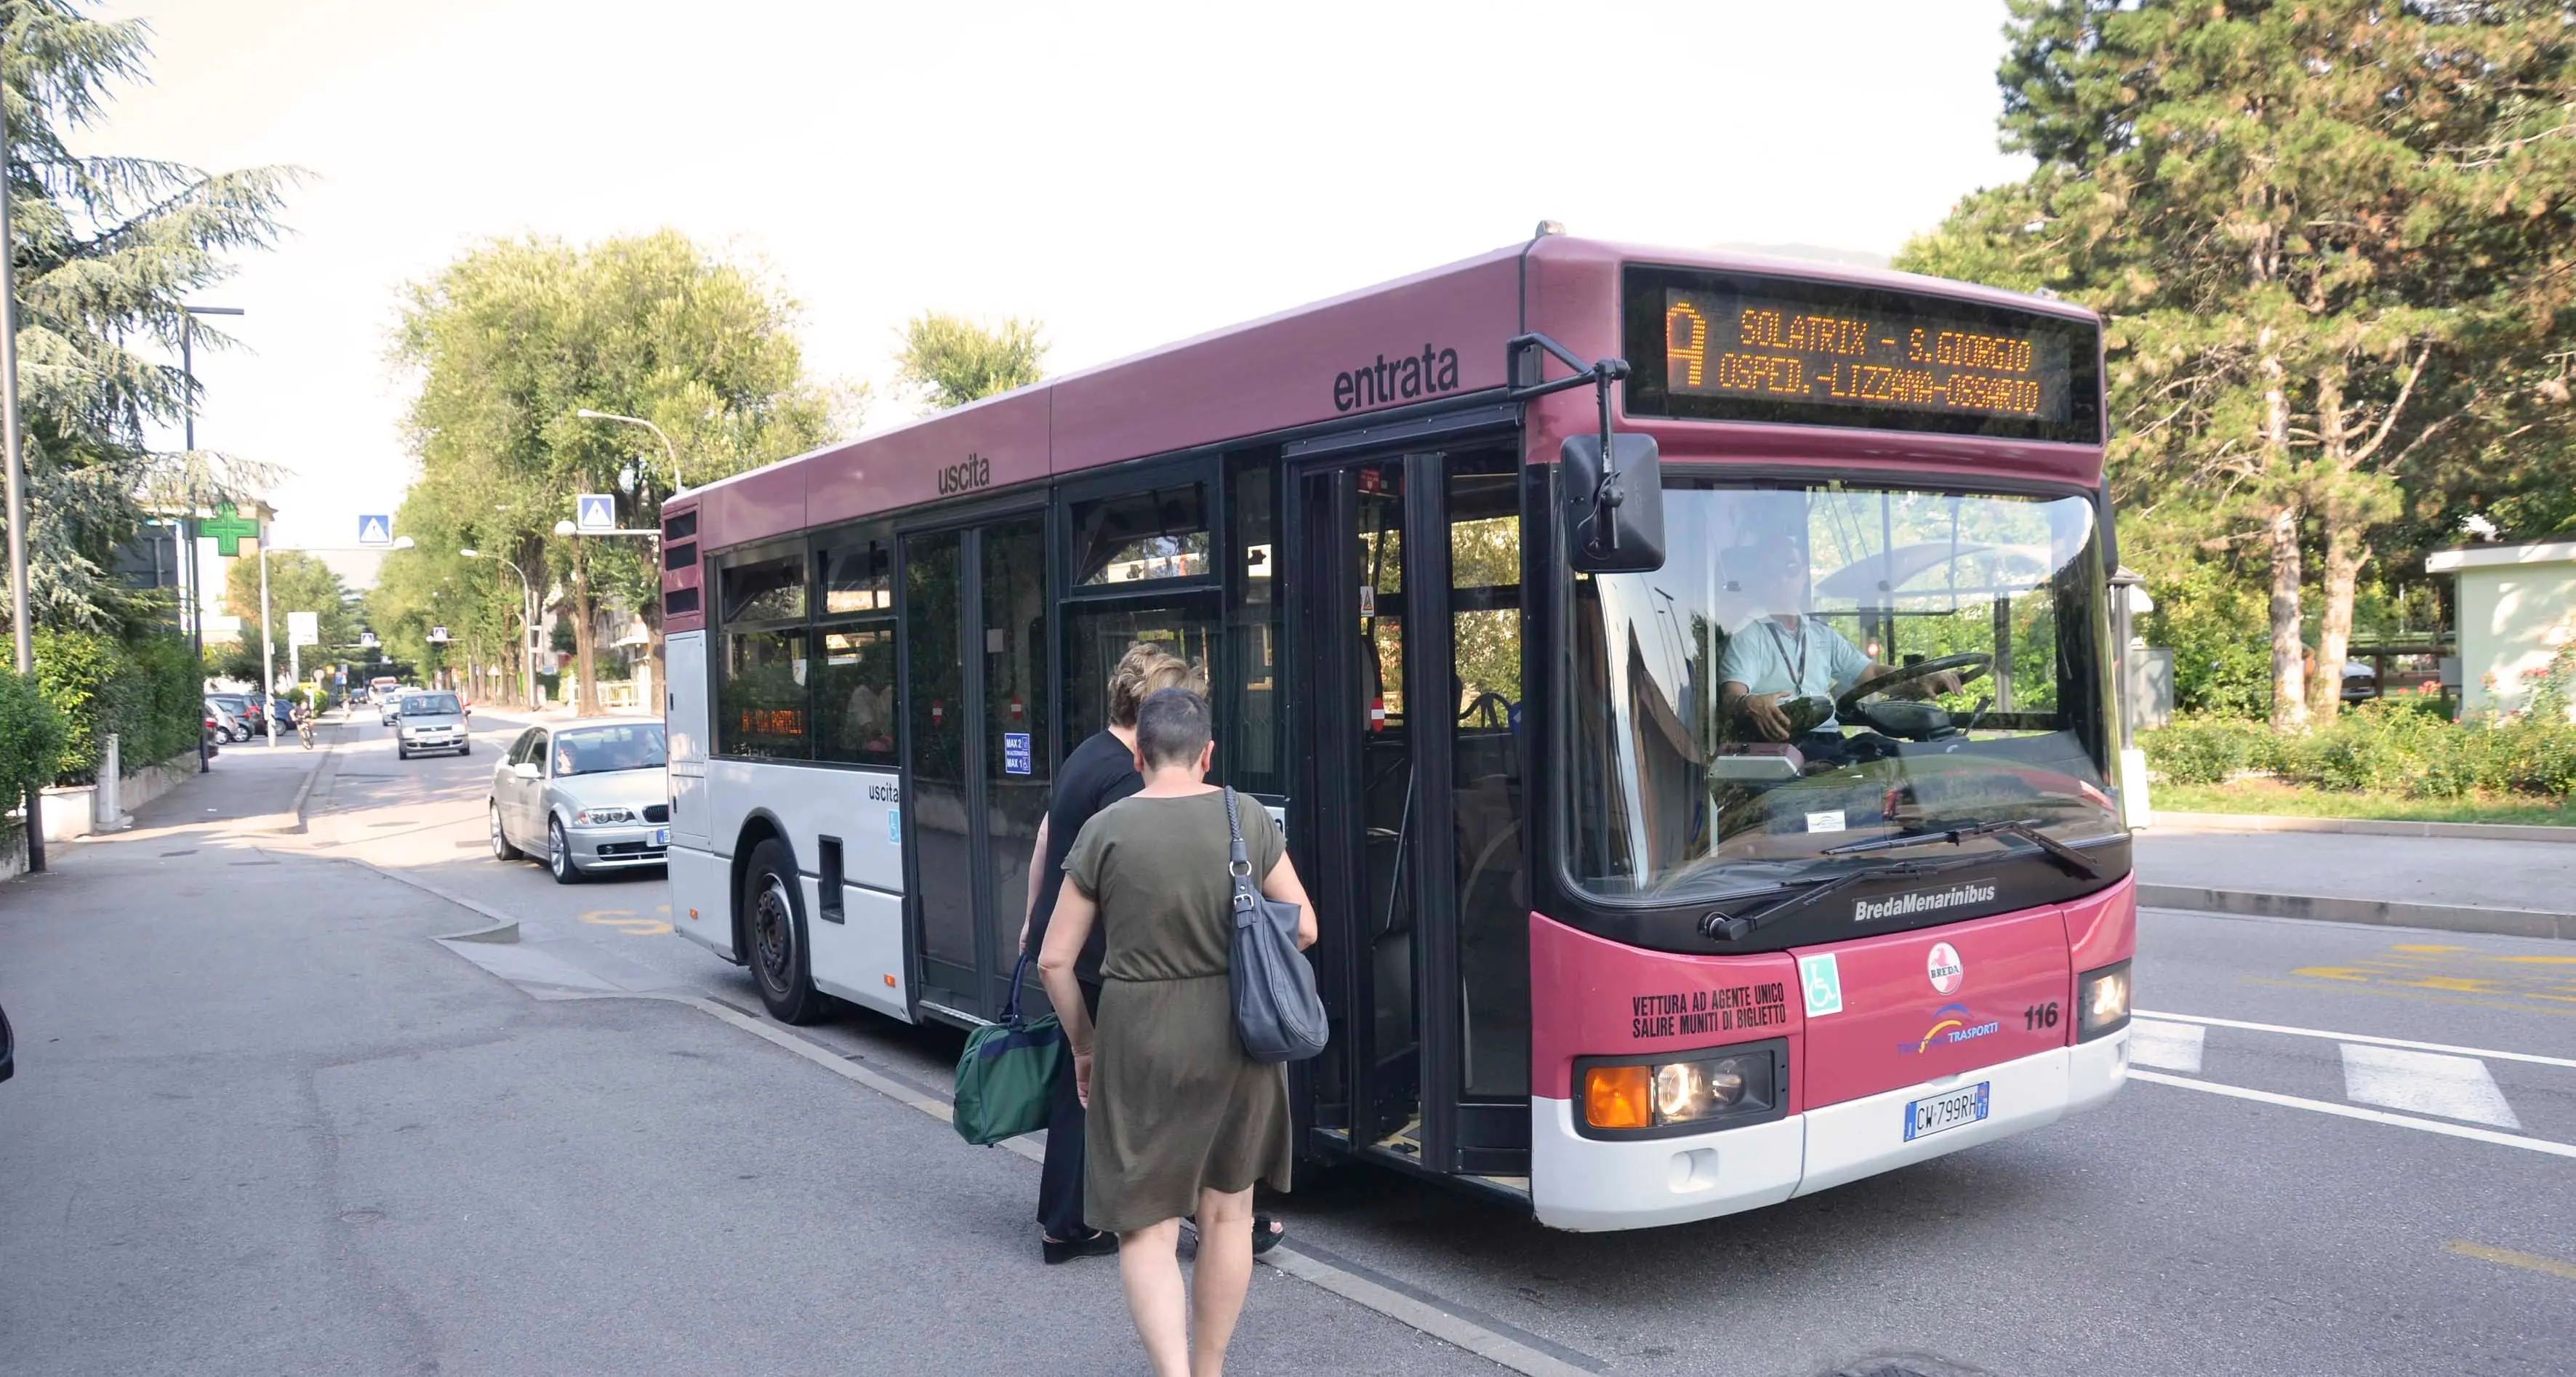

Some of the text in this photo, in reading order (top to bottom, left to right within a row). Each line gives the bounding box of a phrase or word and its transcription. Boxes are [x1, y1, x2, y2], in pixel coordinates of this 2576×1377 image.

[1666, 302, 1706, 386] A
[1741, 308, 1867, 356] SOLATRIX
[1909, 328, 2031, 372] S.GIORGIO
[1333, 343, 1458, 412] entrata
[938, 452, 990, 494] uscita
[869, 782, 899, 803] uscita
[1855, 885, 1995, 921] BredaMenarinibus
[1930, 965, 1959, 979] BREDA
[1632, 982, 1784, 1017] VETTURA AD AGENTE UNICO
[2024, 1002, 2058, 1031] 116
[1633, 1003, 1786, 1038] SALIRE MUNITI DI BIGLIETTO
[1949, 1022, 1999, 1043] TRASPORTI
